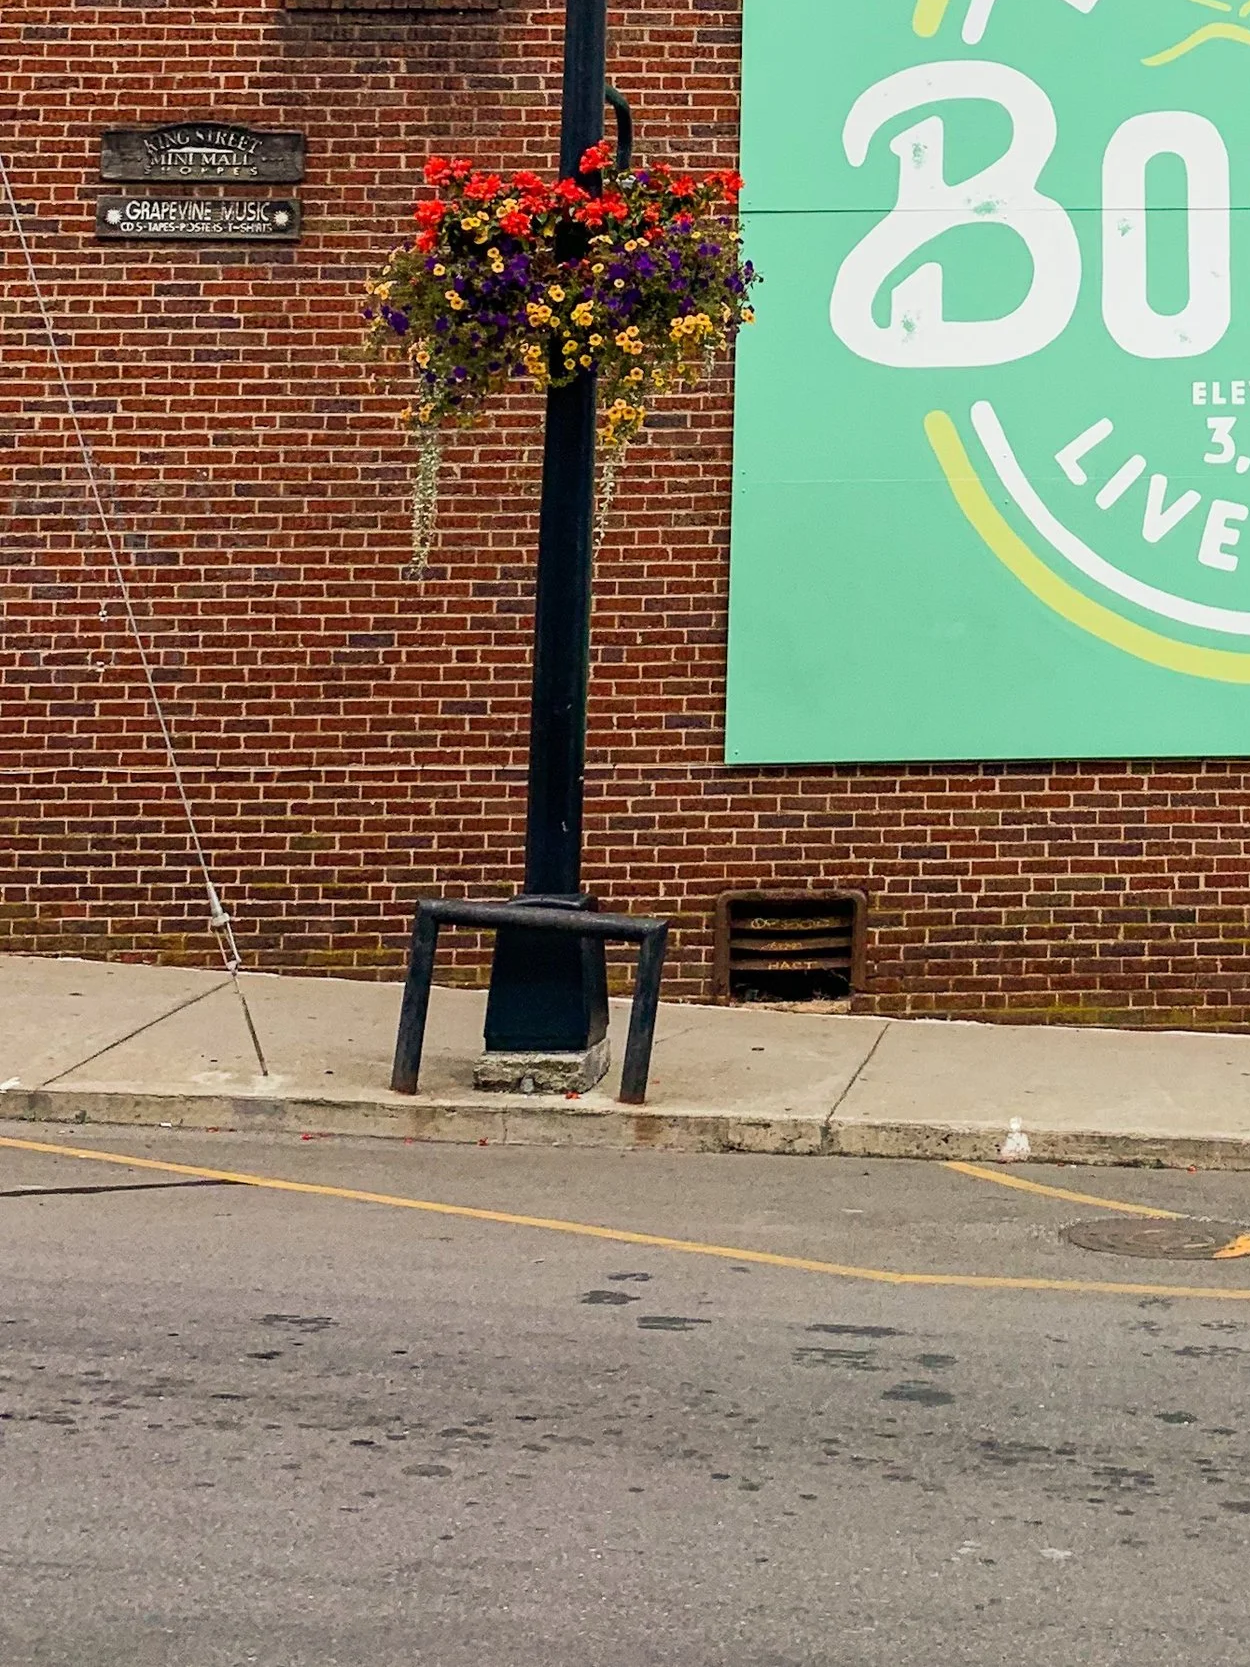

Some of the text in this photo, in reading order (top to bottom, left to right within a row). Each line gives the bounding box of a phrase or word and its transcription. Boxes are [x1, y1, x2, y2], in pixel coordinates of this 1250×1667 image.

[150, 153, 253, 166] MINI MALL
[125, 200, 271, 222] GRAPEVINE MUSIC
[1055, 417, 1249, 572] LIVE
